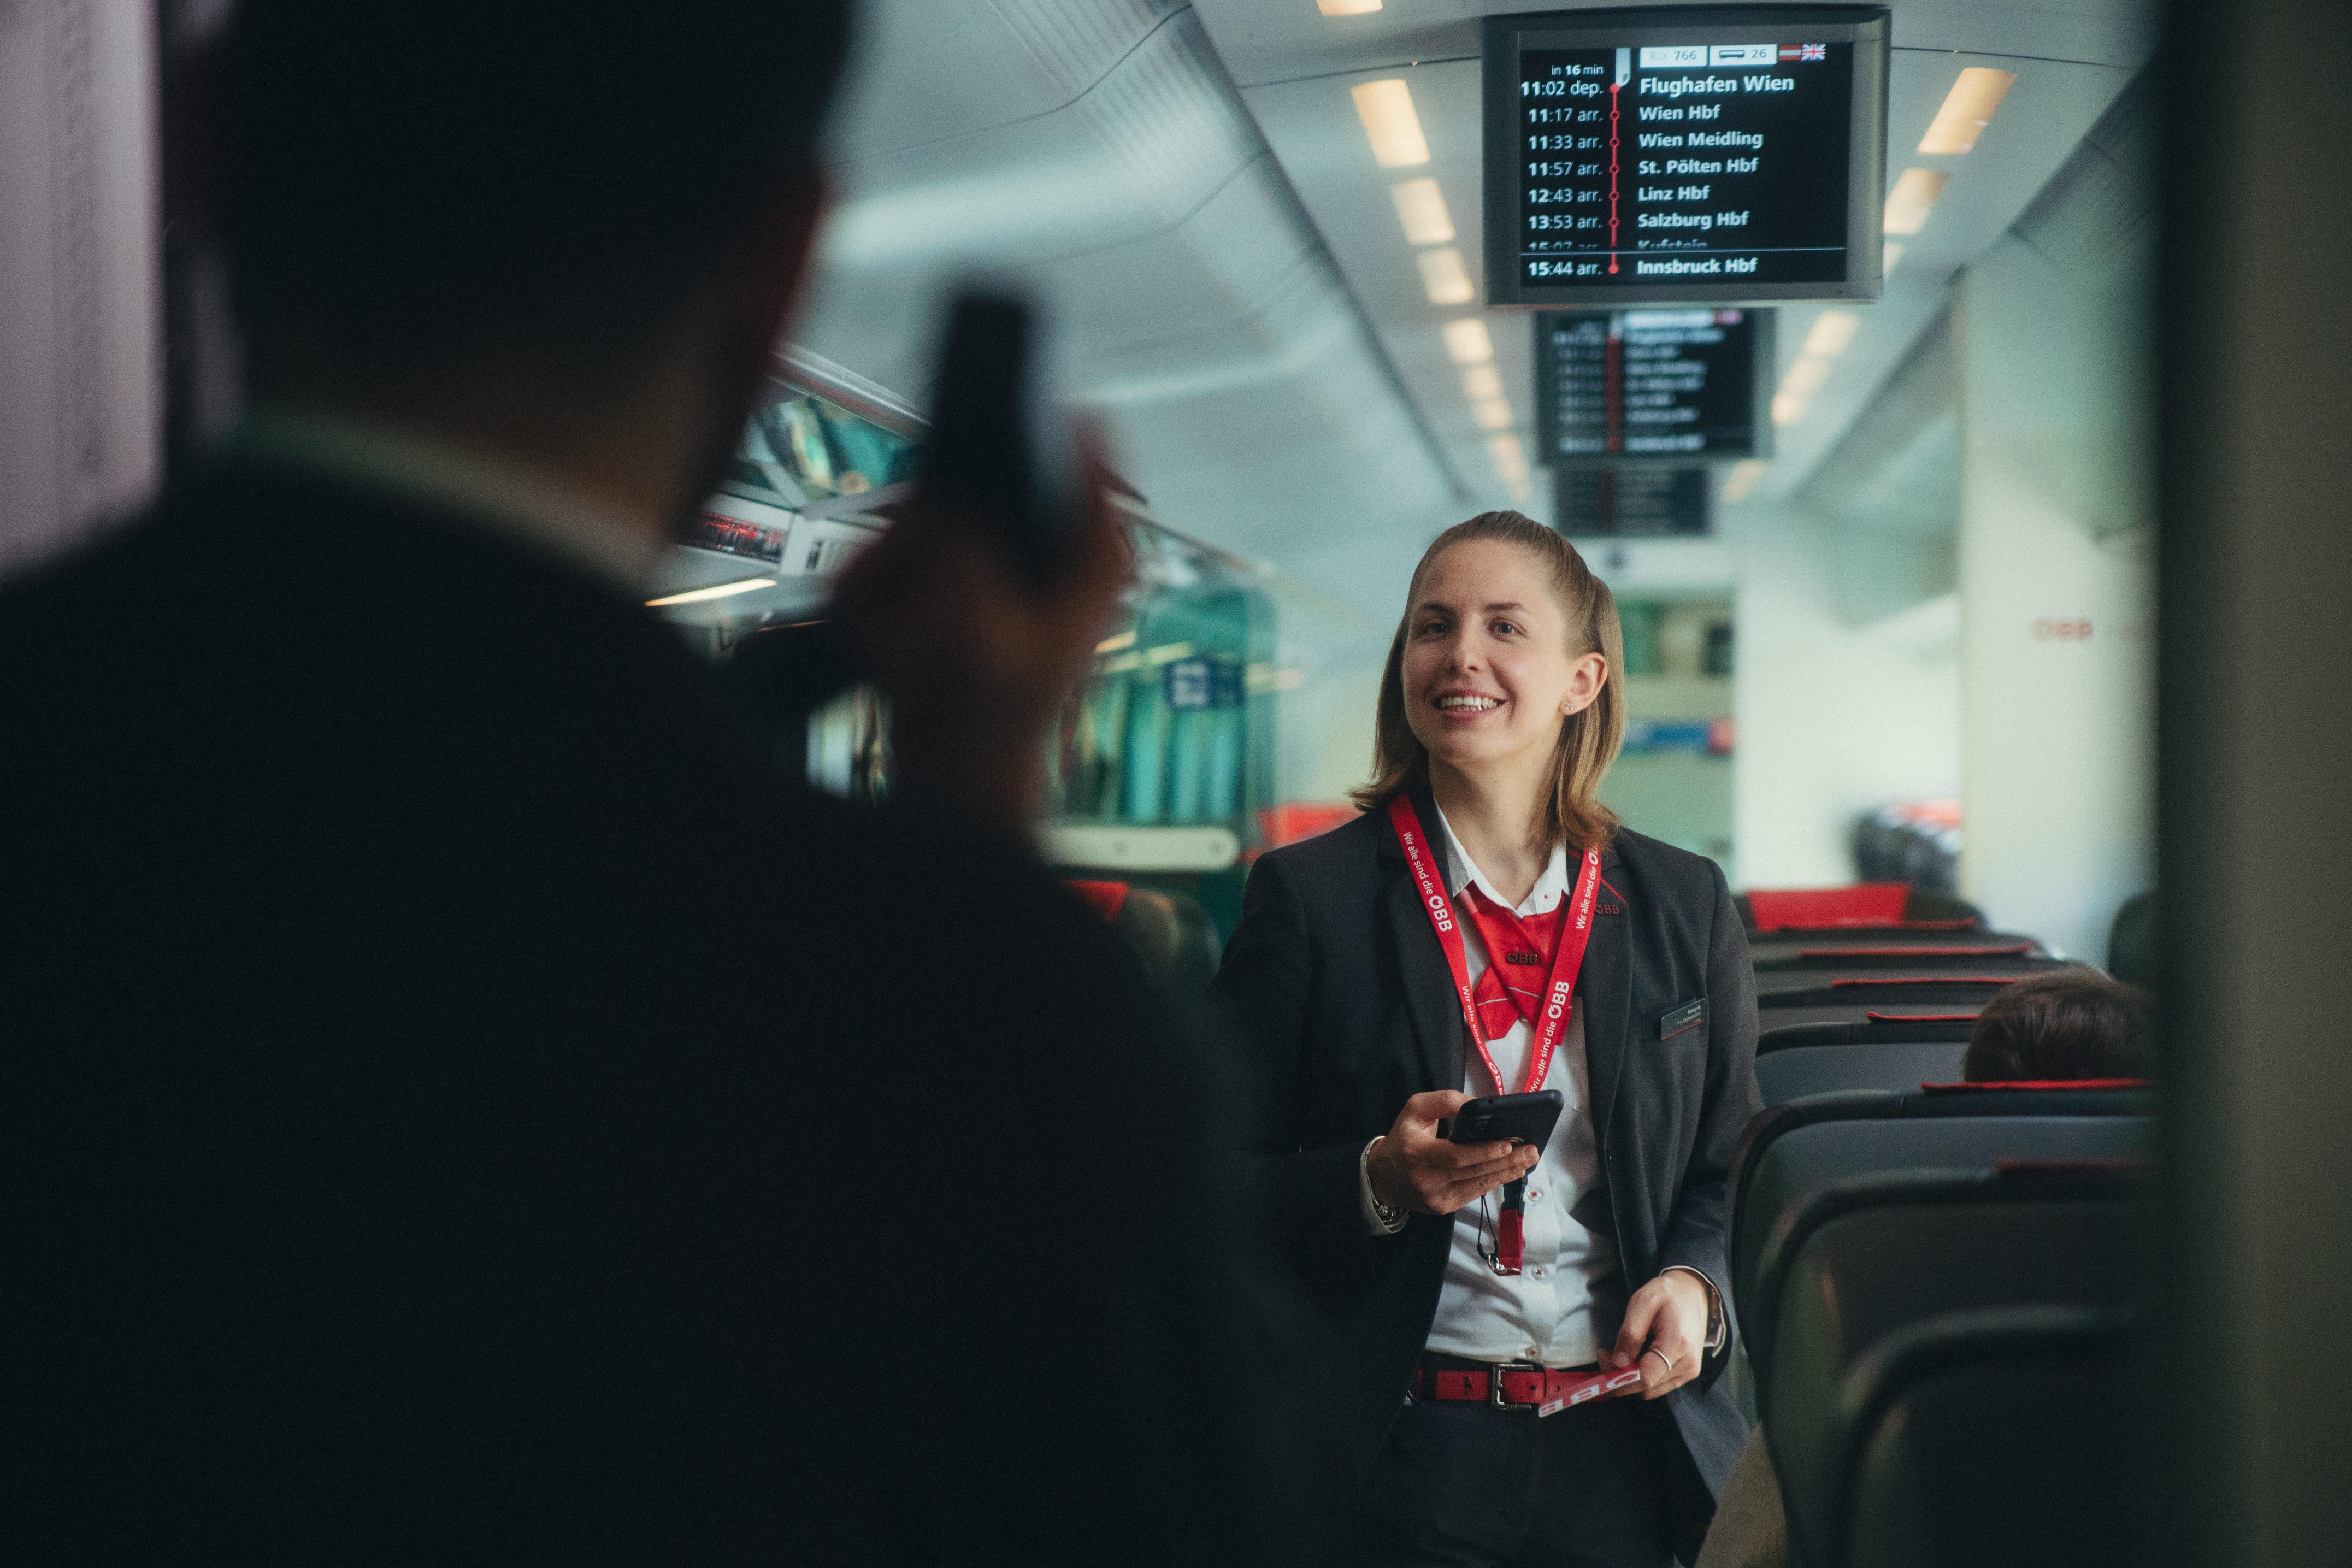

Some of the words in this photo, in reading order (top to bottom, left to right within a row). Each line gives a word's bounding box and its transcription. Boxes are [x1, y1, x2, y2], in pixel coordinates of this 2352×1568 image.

[1674, 51, 1696, 61] 766
[1751, 49, 1766, 58] 26
[1551, 64, 1561, 75] in
[1565, 64, 1582, 76] 16
[1583, 64, 1604, 75] min
[1520, 80, 1565, 96] 11:02
[1570, 80, 1604, 98] dep.
[1640, 75, 1738, 98] Flughafen
[1743, 74, 1794, 92] Wien
[1529, 108, 1573, 122] 11:17
[1577, 110, 1604, 122] arr.
[1639, 105, 1683, 121] Wien
[1688, 104, 1720, 120] Hbf
[1529, 135, 1572, 149] 11:33
[1577, 138, 1604, 149] arr.
[1638, 133, 1683, 148] Wien
[1688, 131, 1763, 149] Meidling
[1529, 162, 1572, 176] 11:57
[1577, 164, 1604, 175] arr.
[1639, 160, 1661, 174] St.
[1666, 158, 1722, 174] Pölten
[1726, 157, 1758, 173] Hbf
[1529, 188, 1572, 203] 12:43
[1577, 191, 1604, 202] arr.
[1638, 187, 1673, 201] Linz
[1678, 185, 1710, 200] Hbf
[1529, 215, 1572, 229] 13:53
[1577, 217, 1604, 229] arr.
[1638, 213, 1712, 230] Salzburg
[1717, 211, 1749, 226] Hbf
[1528, 261, 1573, 276] 15:44
[1576, 264, 1604, 275] arr.
[1637, 258, 1721, 274] Innsbruck
[1725, 257, 1758, 273] Hbf
[1403, 831, 1414, 845] Wir
[1408, 845, 1419, 860] alle
[1414, 860, 1429, 880] sind
[1589, 866, 1597, 880] die
[1423, 880, 1433, 895] die
[1584, 879, 1594, 899] sind
[1580, 899, 1590, 913] alle
[1576, 915, 1587, 929] Wir
[1462, 985, 1470, 1003] Wir
[1472, 1023, 1482, 1044] sind
[1479, 1046, 1488, 1060] die
[1546, 1021, 1557, 1036] die
[1540, 1037, 1552, 1059] sind
[1538, 1059, 1546, 1076] alle
[1529, 1077, 1541, 1093] Wir
